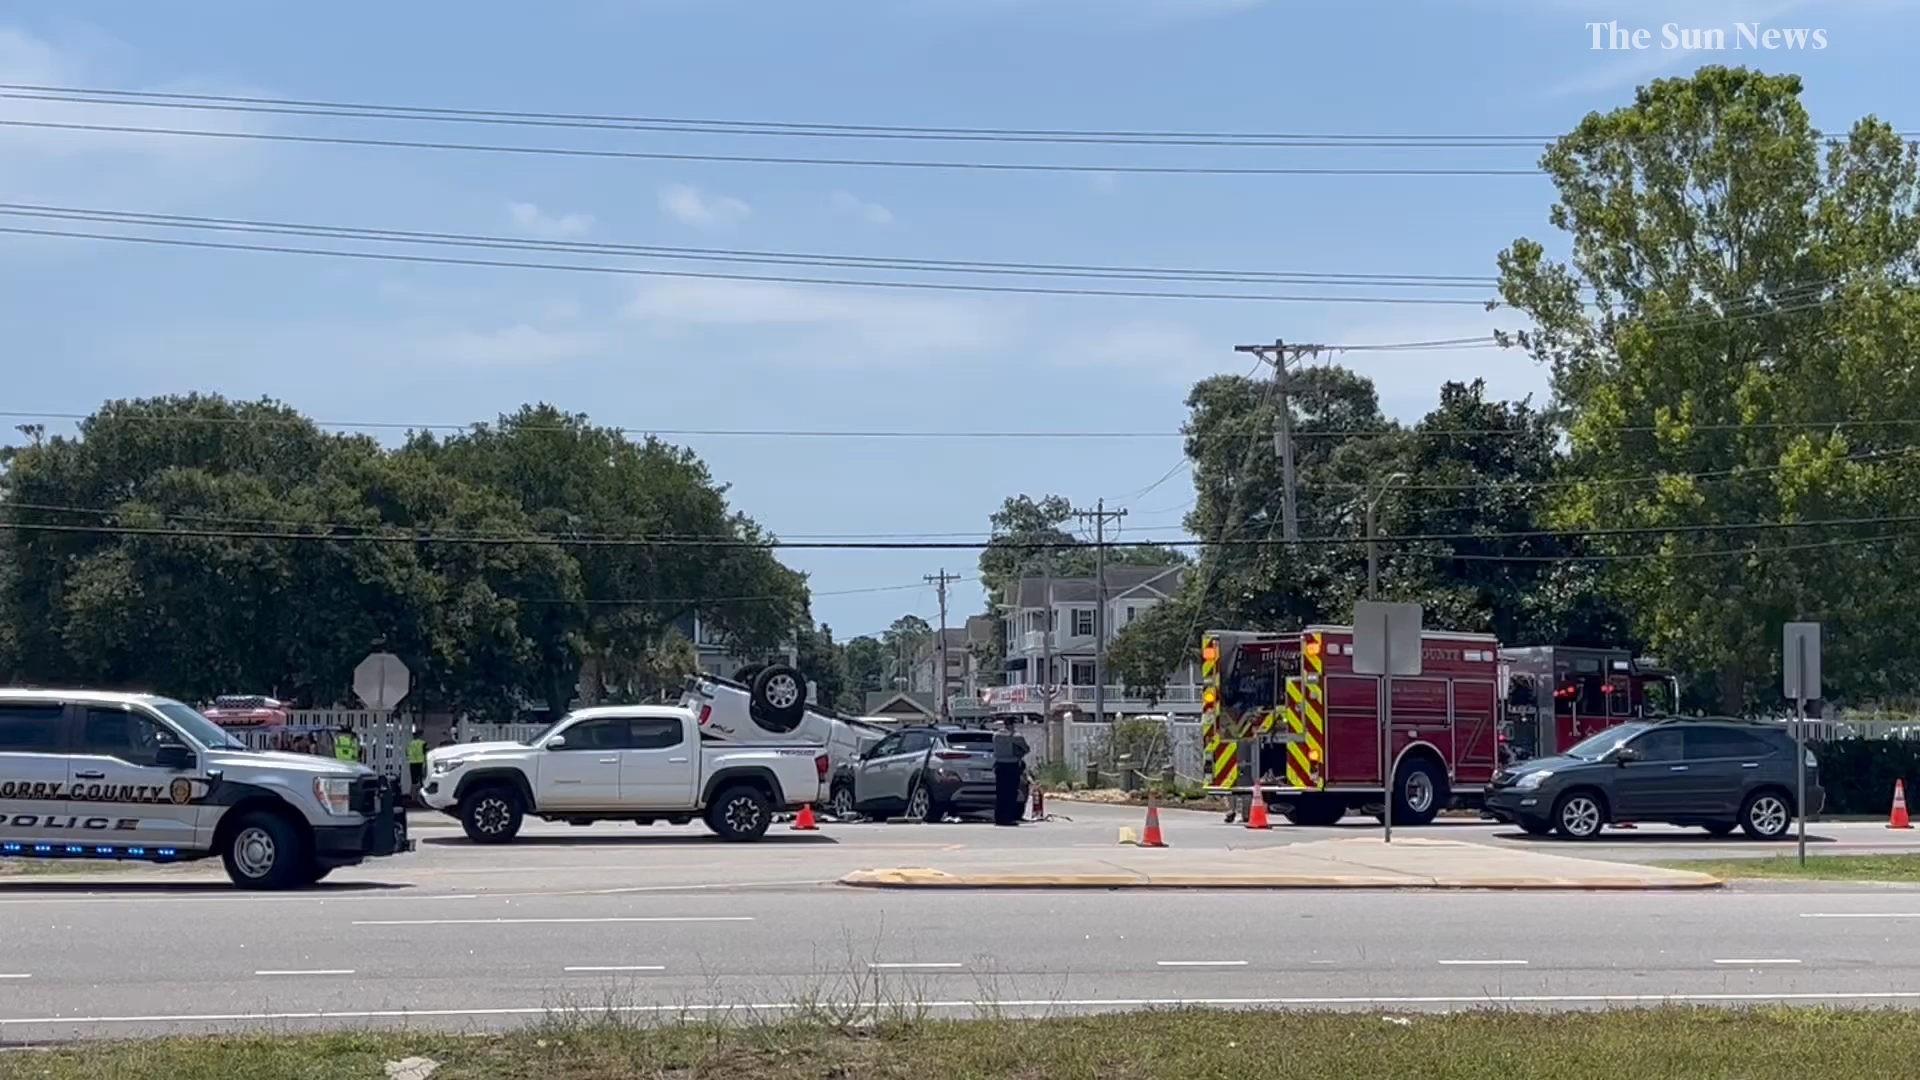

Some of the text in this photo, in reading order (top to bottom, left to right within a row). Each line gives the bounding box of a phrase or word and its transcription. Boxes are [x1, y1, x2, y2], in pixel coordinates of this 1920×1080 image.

[1422, 647, 1461, 660] OUNTY
[0, 781, 165, 802] ORRY COUNTY
